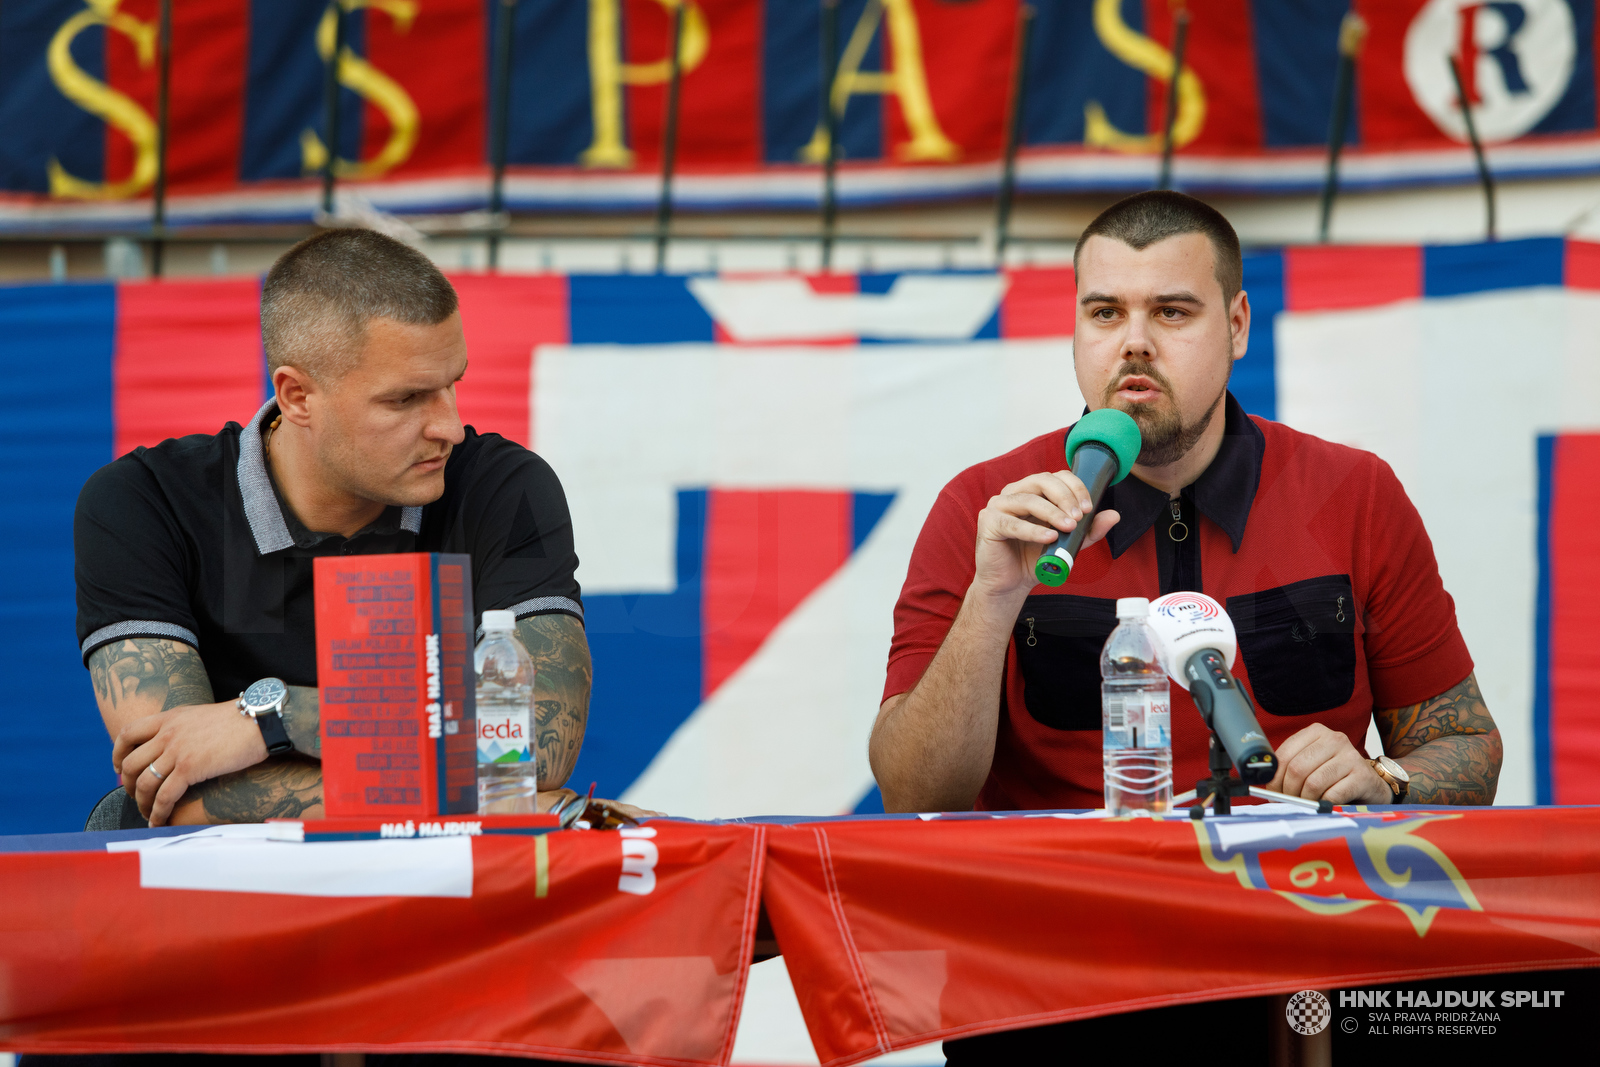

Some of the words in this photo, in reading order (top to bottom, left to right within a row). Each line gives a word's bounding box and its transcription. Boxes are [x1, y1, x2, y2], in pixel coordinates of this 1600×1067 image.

[425, 633, 441, 699] HAJDUK
[425, 702, 442, 738] NAŠ
[477, 718, 523, 739] leda
[380, 820, 416, 839] NAŠ
[418, 821, 483, 838] HAJDUK
